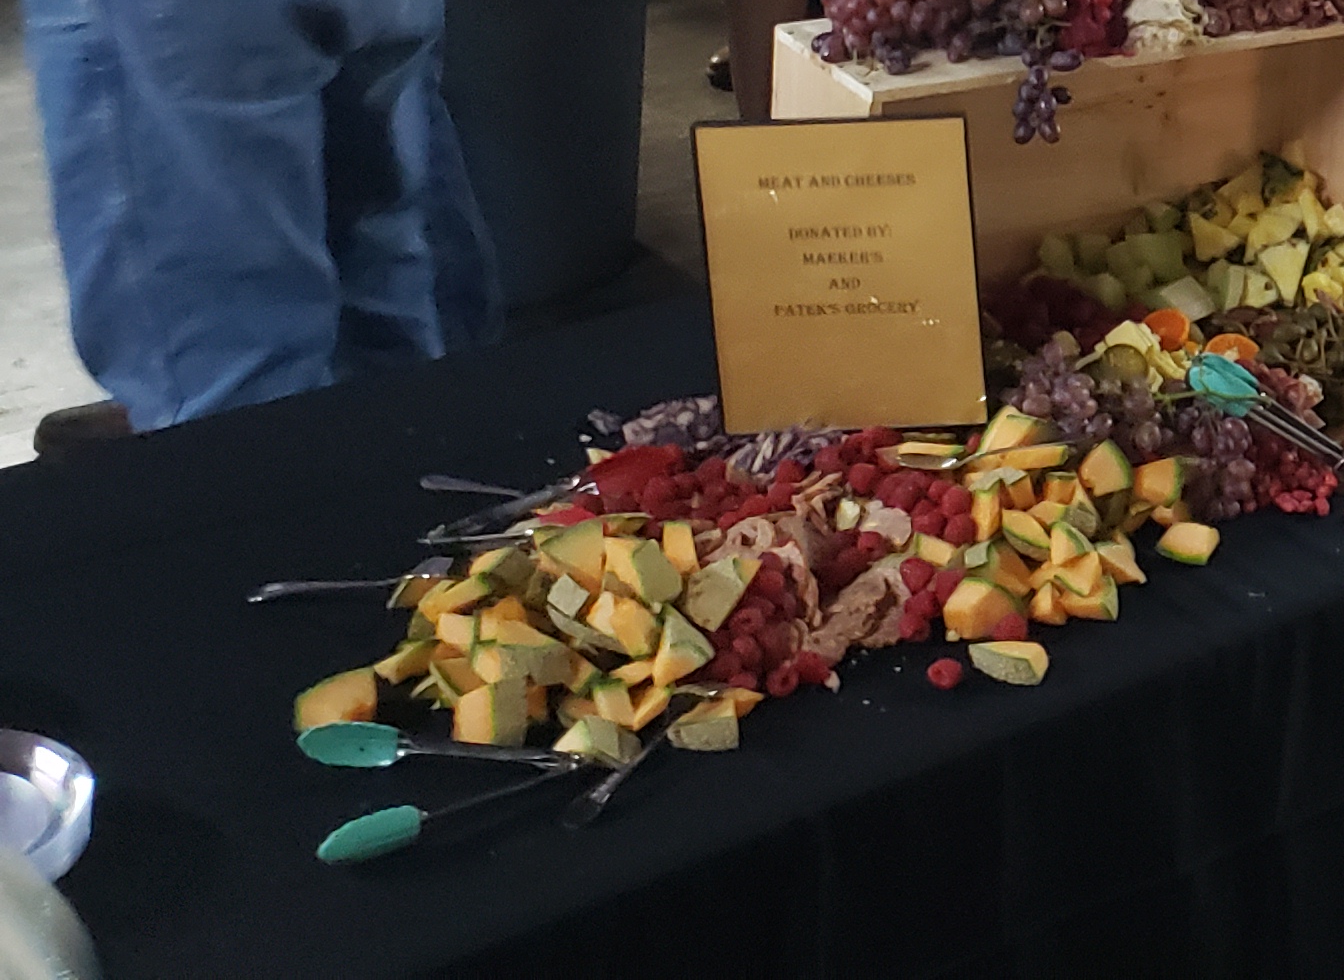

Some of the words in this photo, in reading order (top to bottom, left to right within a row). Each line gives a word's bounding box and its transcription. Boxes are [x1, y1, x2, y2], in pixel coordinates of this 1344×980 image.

[758, 176, 803, 190] MEAT
[809, 175, 841, 188] AND
[844, 173, 917, 188] CHEESES
[788, 225, 863, 241] DONATED
[828, 276, 861, 290] AND
[774, 303, 841, 317] PATEK'S
[844, 299, 920, 315] GROCERY
